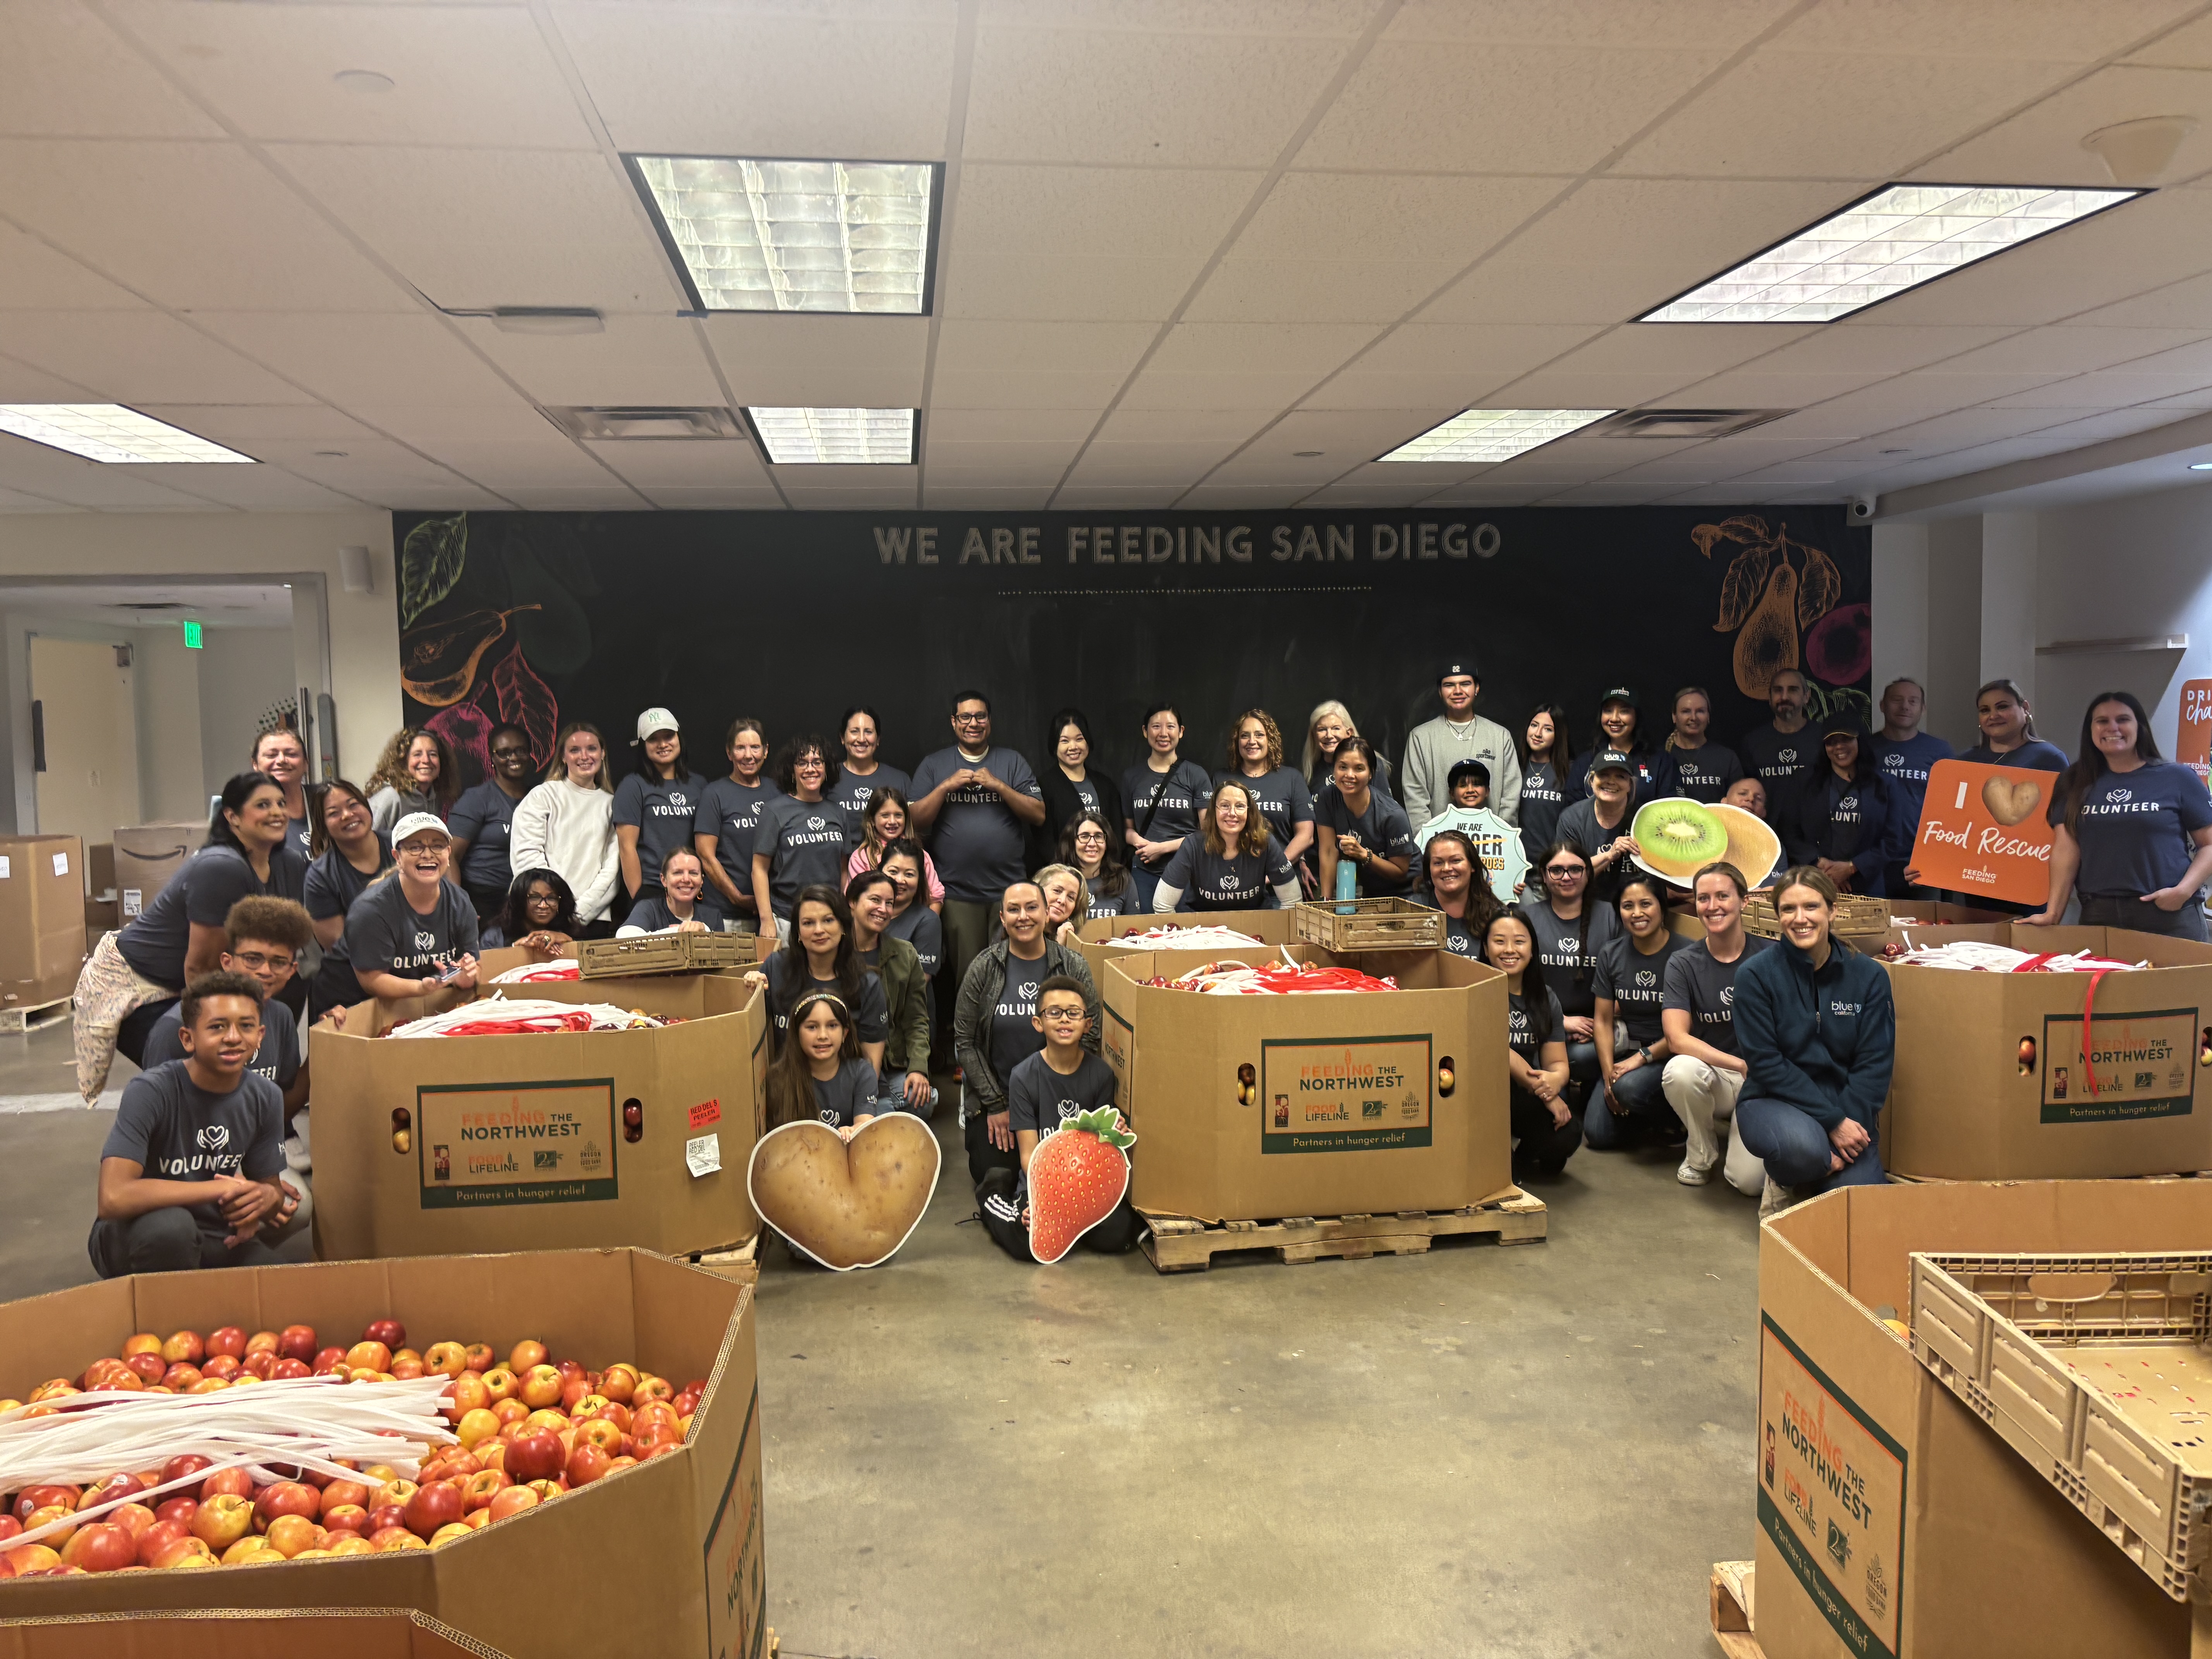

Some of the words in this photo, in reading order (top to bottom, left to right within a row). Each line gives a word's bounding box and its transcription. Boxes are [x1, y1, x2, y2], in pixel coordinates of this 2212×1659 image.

[873, 526, 939, 564] WE
[958, 527, 1041, 564] ARE
[1068, 525, 1252, 564] FEEDING
[1271, 524, 1354, 562] SAN
[1372, 522, 1501, 562] DIEGO
[1759, 765, 1805, 778] VOLUN
[1882, 769, 1927, 781] NTEER
[1682, 776, 1721, 785] NTEER
[945, 792, 1005, 804] VOLUNTEE
[1522, 790, 1561, 802] UNTEER
[1955, 781, 1968, 809] I
[1134, 799, 1189, 809] VOLNTEER
[2082, 802, 2160, 815] OLUNTEER
[652, 806, 695, 816] VOLUNT
[1457, 823, 1467, 831] WE
[1468, 823, 1483, 831] ARE
[1923, 821, 1972, 849] Food
[1977, 827, 2051, 862] Rescue
[1963, 867, 1997, 879] FEEDING
[1975, 876, 1995, 884] DIEGO
[1199, 885, 1260, 901] VOLUNTEER
[1540, 954, 1597, 967] OLUNTEE
[1831, 1000, 1853, 1011] blue
[1301, 1056, 1374, 1079] FEEDING
[1378, 1066, 1396, 1074] THE
[1300, 1075, 1404, 1091] NORTHWEST
[2083, 1084, 2123, 1092] LIELINE
[690, 1105, 702, 1115] RED
[702, 1101, 712, 1111] DEL
[2070, 1108, 2105, 1116] Partners
[2119, 1106, 2146, 1115] hunger
[2150, 1102, 2170, 1111] relief
[551, 1113, 572, 1122] THE
[693, 1109, 715, 1121] PEELER
[1306, 1112, 1350, 1121] LIFELINE
[461, 1123, 582, 1141] NORTHWEST
[1293, 1138, 1332, 1147] Partners
[1348, 1135, 1379, 1145] hunger
[1382, 1132, 1405, 1143] relief
[469, 1163, 519, 1173] LIFELINE
[457, 1190, 501, 1200] Partners
[505, 1190, 515, 1199] in
[518, 1187, 555, 1199] hunger
[559, 1184, 586, 1195] relief
[1784, 1390, 1843, 1472] FEEDING
[1846, 1463, 1865, 1497] THE
[1782, 1412, 1872, 1530] NORTHWEST
[1775, 1517, 1802, 1568] Partners
[1804, 1561, 1811, 1582] in
[1813, 1570, 1841, 1620] hunger
[1843, 1617, 1868, 1652] relief
[1867, 1570, 1887, 1598] OREGON
